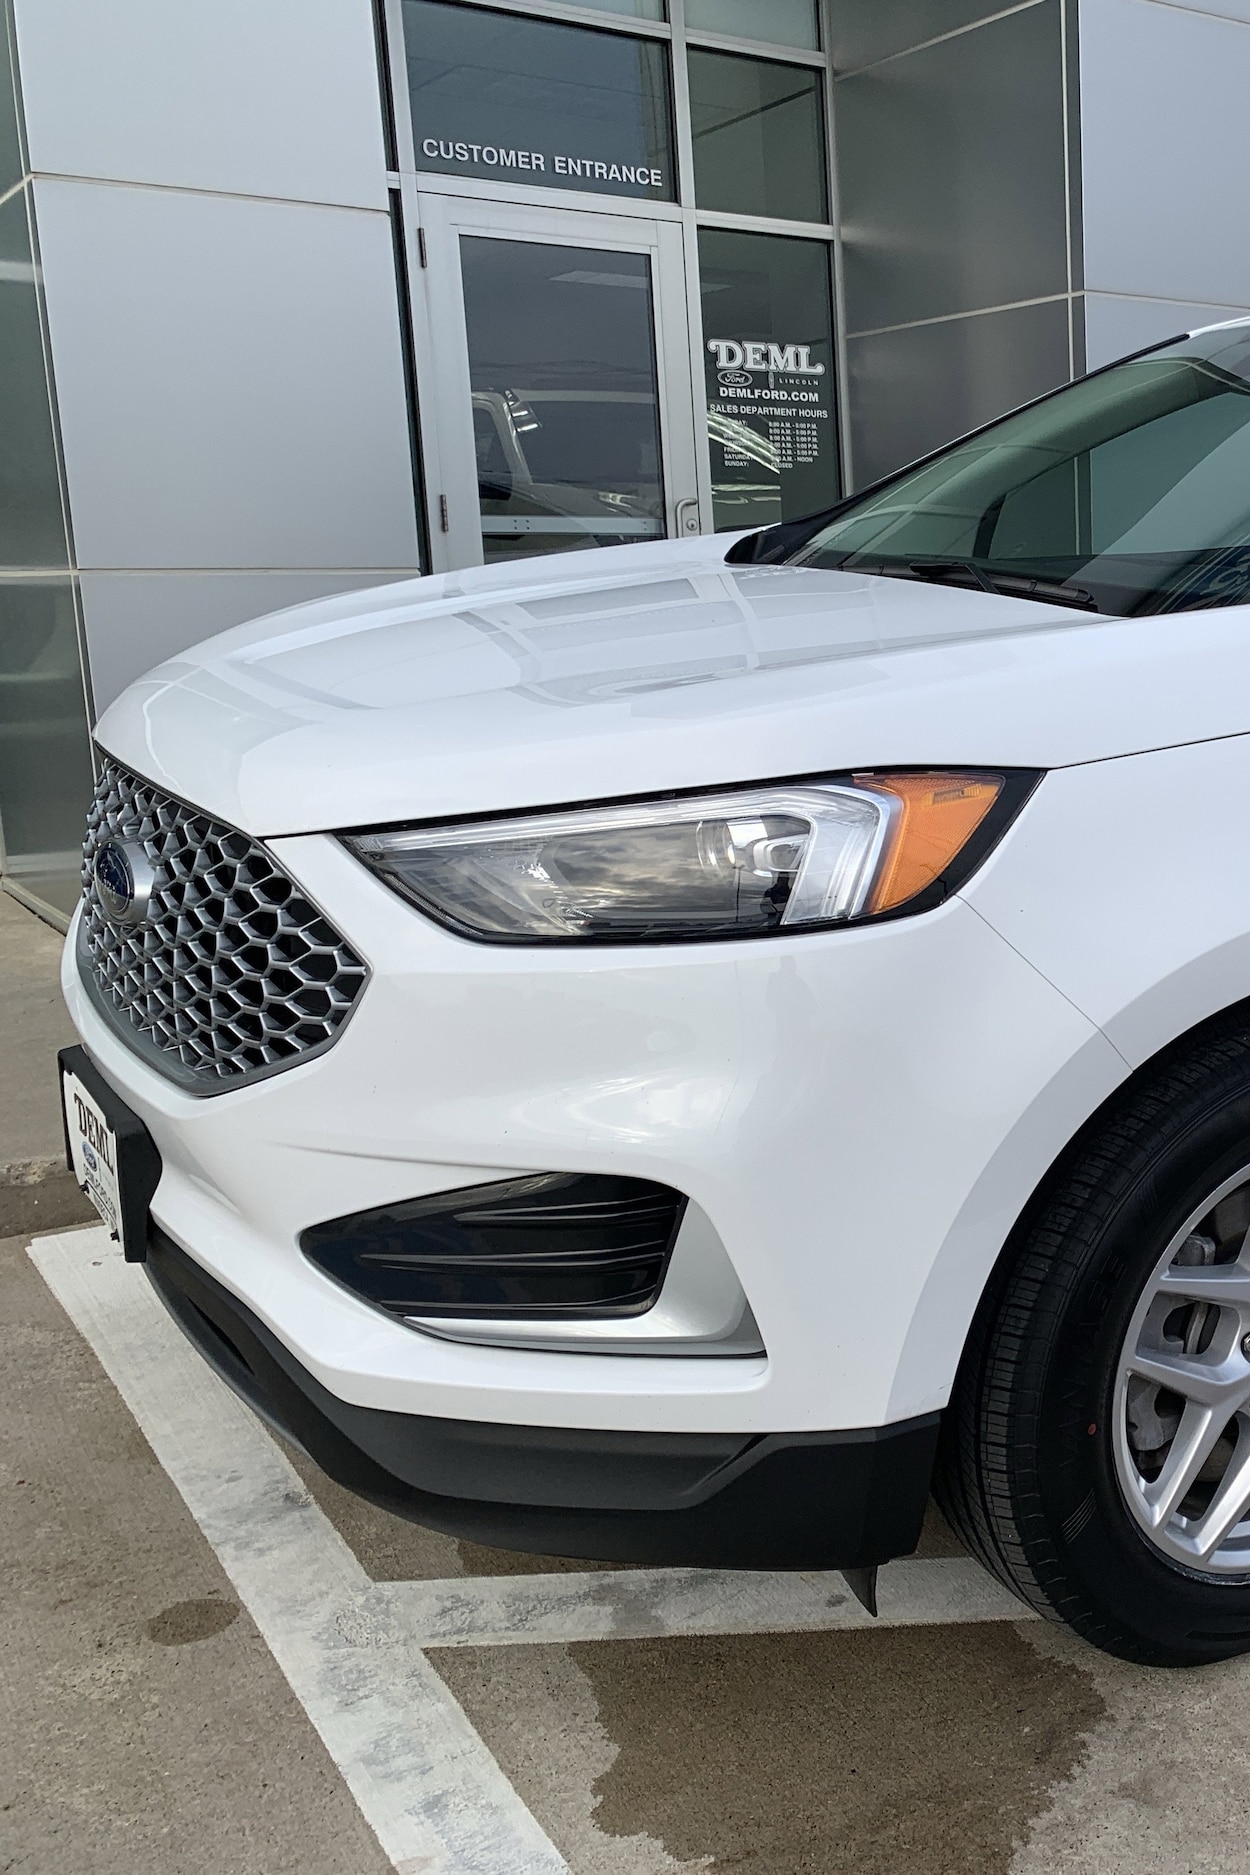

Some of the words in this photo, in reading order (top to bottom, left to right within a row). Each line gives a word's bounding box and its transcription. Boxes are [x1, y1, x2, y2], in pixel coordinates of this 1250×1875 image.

[422, 138, 545, 171] CUSTOMER
[554, 156, 663, 186] ENTRANCE
[707, 339, 825, 375] DEML
[710, 404, 738, 414] SALES
[740, 406, 797, 416] DEPARTMENT
[799, 408, 828, 418] HOURS
[720, 387, 818, 402] DEMLFORD.COM
[74, 1093, 114, 1176] DEML
